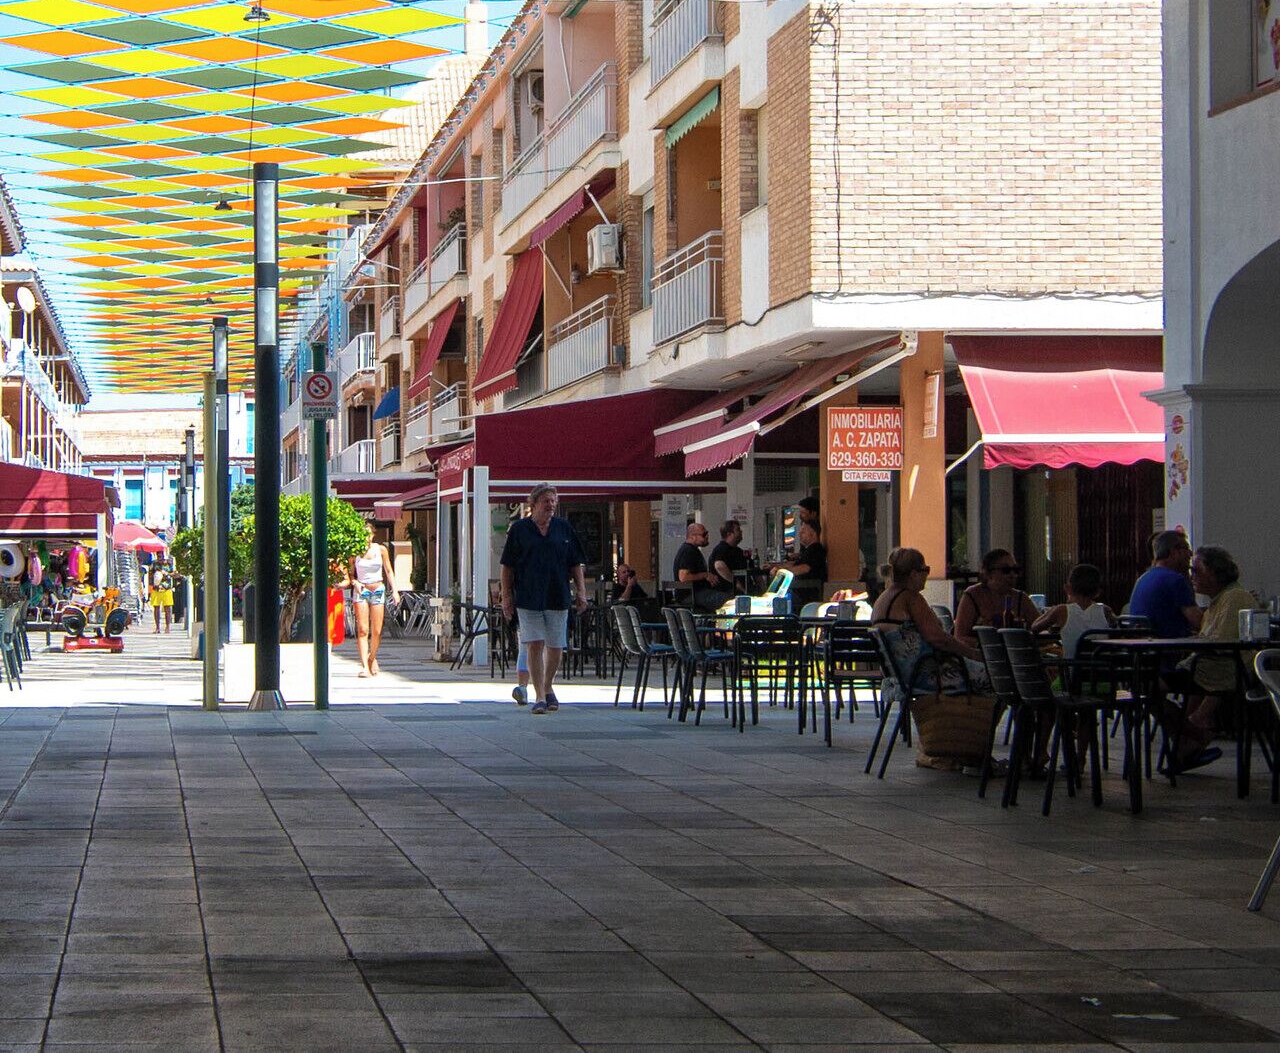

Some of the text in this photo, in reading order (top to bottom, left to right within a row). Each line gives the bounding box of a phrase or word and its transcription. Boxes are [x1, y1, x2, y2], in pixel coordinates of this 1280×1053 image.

[831, 413, 901, 429] INMOBILIARIA
[832, 432, 900, 448] A. C. ZAPATA
[830, 451, 901, 466] 629-360-330
[844, 472, 890, 480] CITA PREVIA
